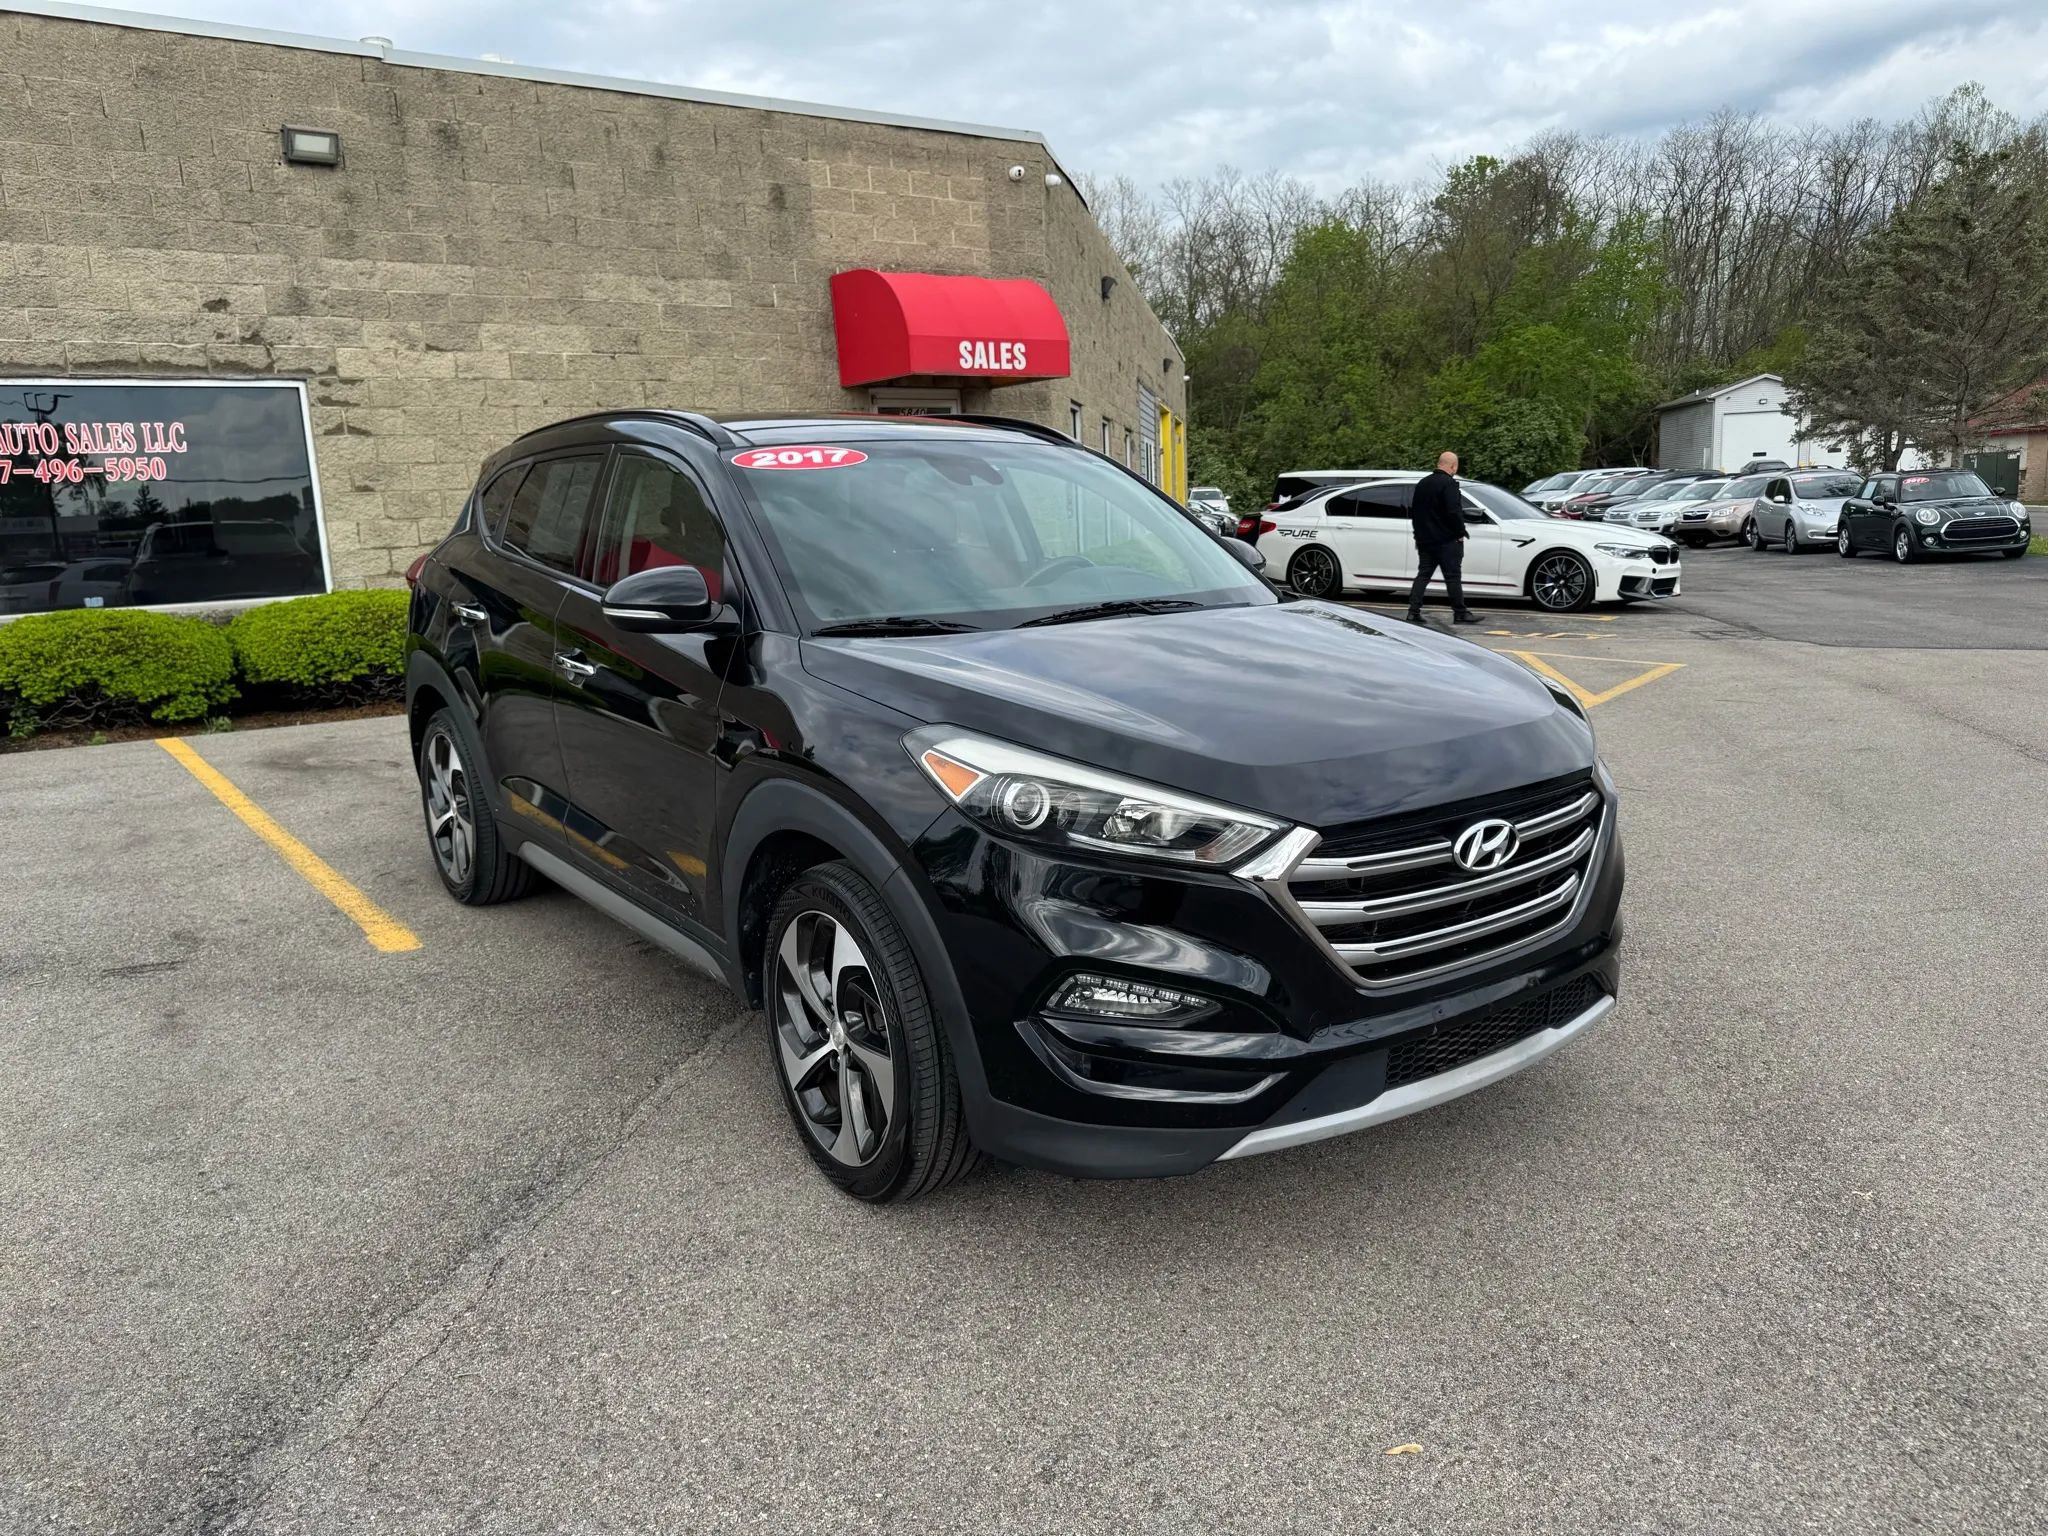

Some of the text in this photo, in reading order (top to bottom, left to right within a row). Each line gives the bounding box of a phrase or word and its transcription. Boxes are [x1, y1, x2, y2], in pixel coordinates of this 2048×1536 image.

[959, 340, 1026, 370] SALES
[64, 422, 137, 454] SALES
[141, 422, 187, 453] LLC
[751, 449, 849, 467] 2017
[1277, 529, 1319, 538] PURE
